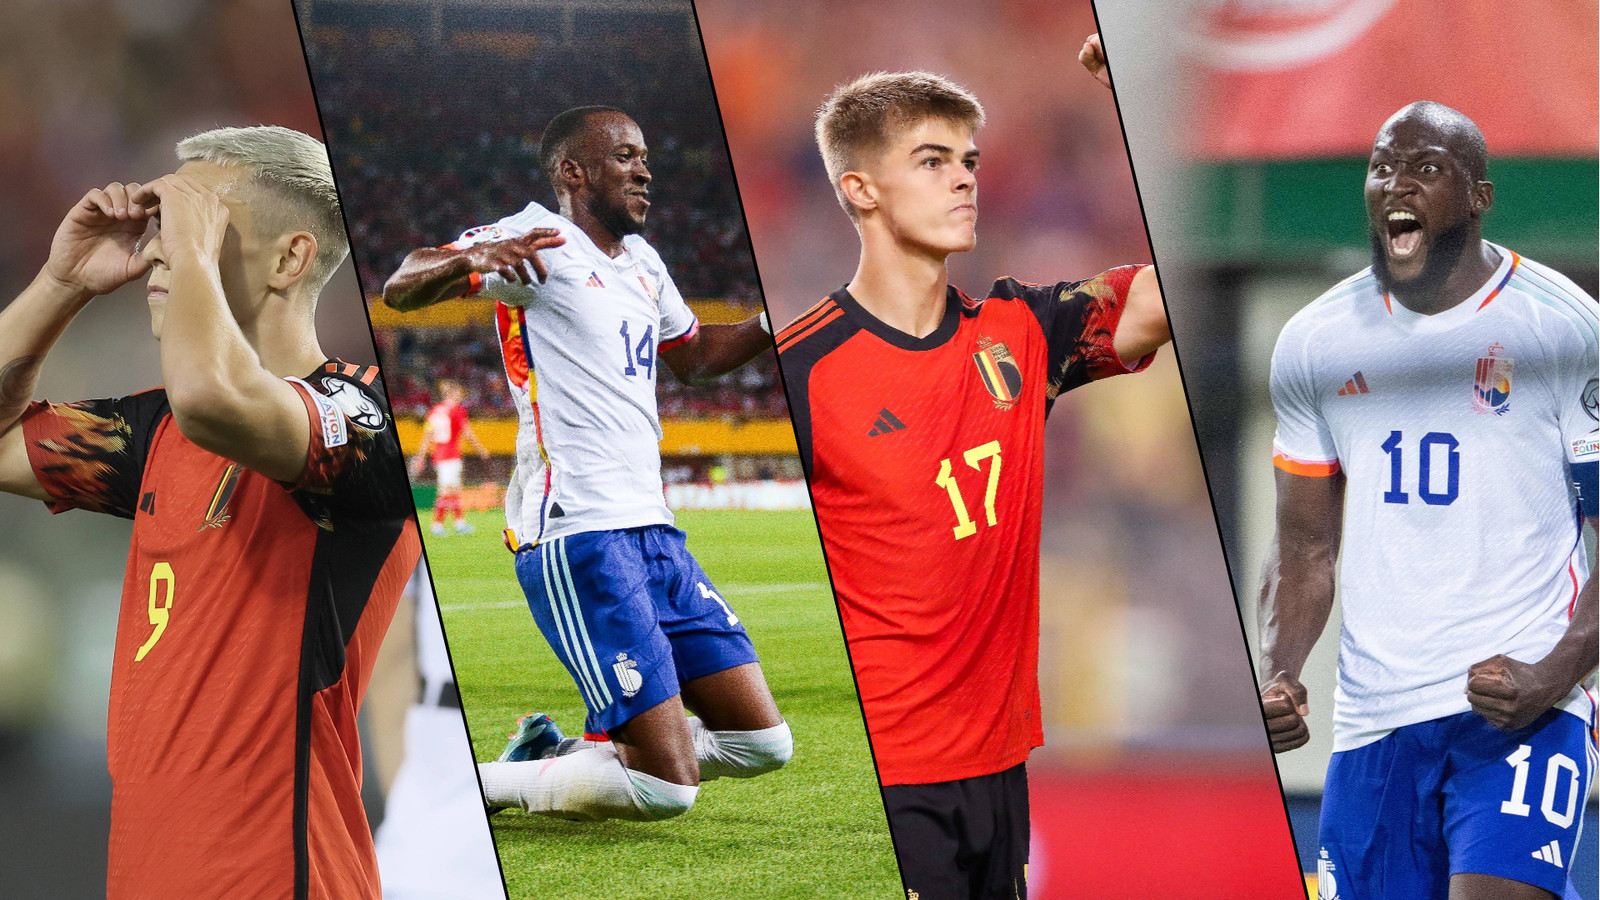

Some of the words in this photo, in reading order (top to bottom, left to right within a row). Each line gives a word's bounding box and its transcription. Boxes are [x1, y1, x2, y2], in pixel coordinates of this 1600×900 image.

[620, 321, 653, 379] 14
[935, 440, 1001, 540] 17
[1381, 431, 1459, 505] 10
[134, 562, 175, 662] 9
[1501, 745, 1579, 829] 10
